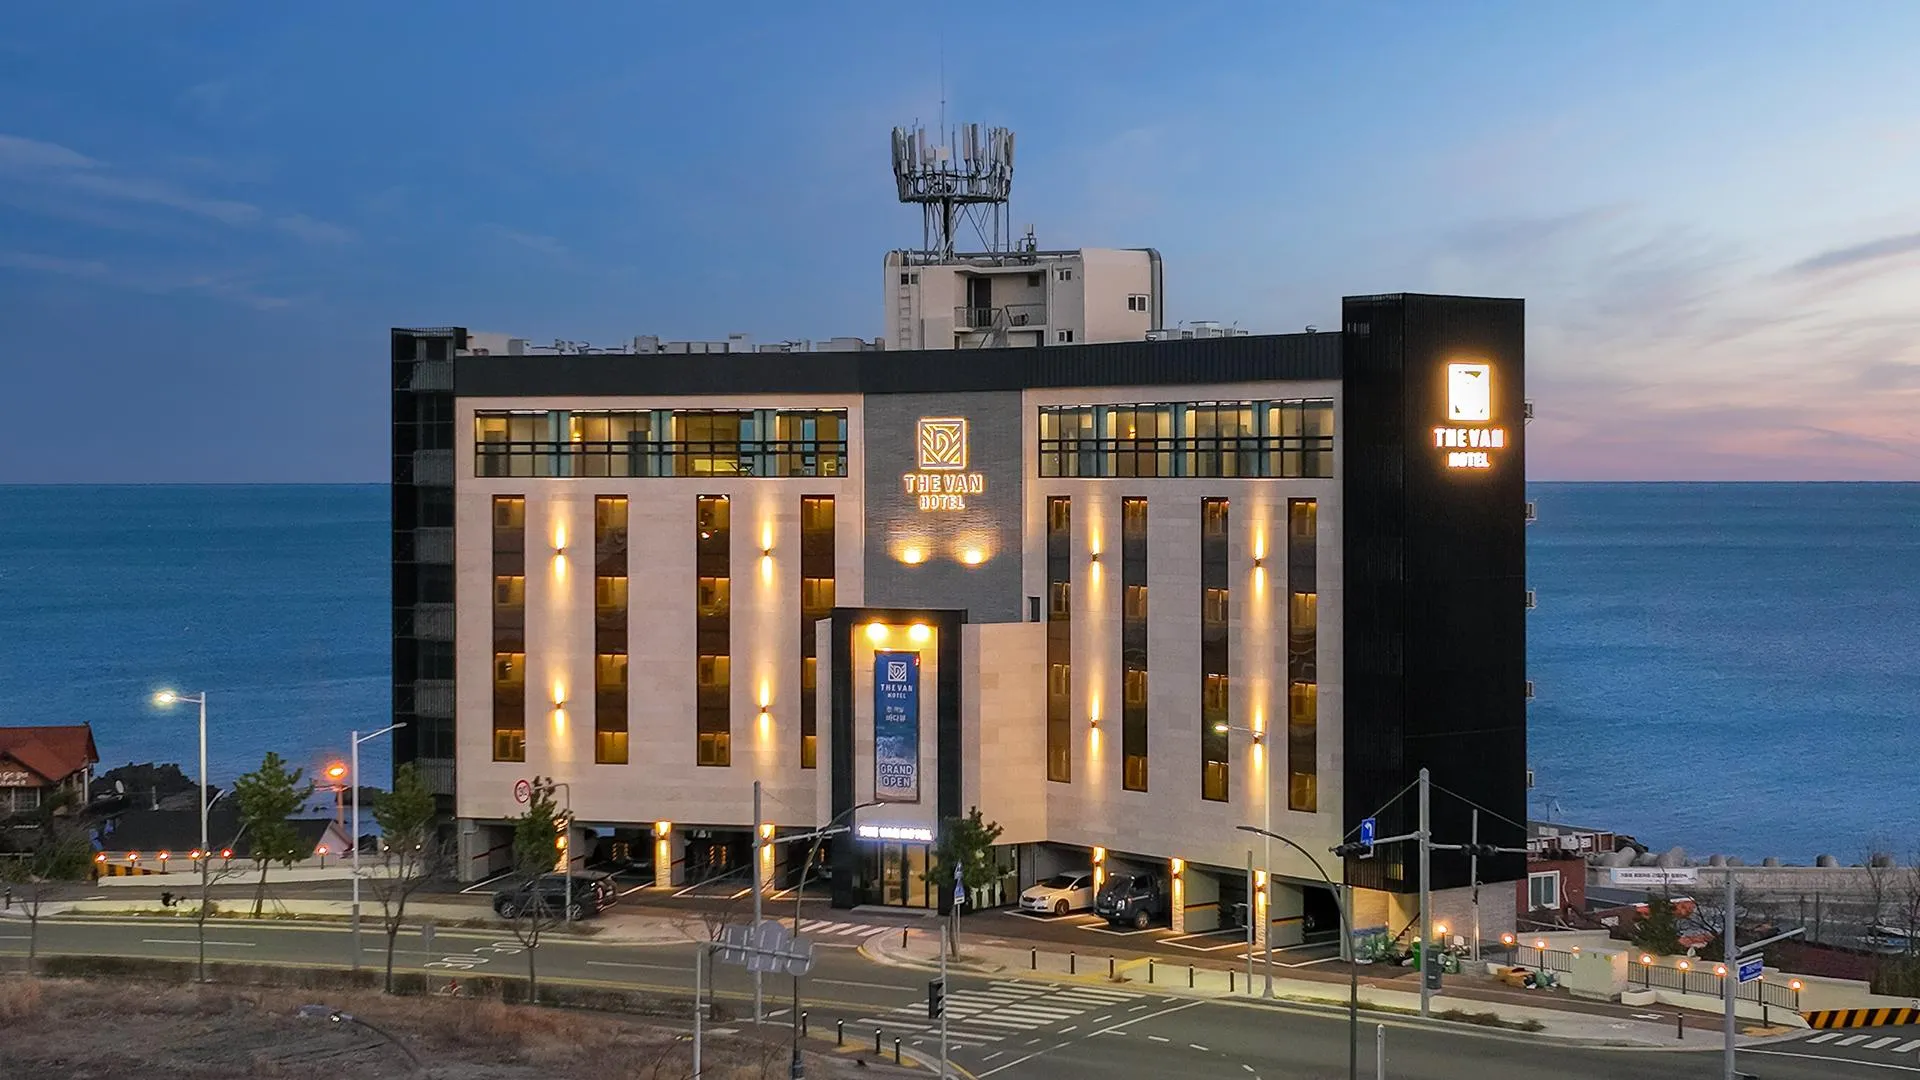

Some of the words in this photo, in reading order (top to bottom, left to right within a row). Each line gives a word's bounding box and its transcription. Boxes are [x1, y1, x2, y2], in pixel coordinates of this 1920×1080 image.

[903, 474, 941, 493] THE
[943, 474, 983, 493] VAN
[919, 494, 966, 510] HOTEL
[880, 684, 896, 692] THE
[897, 684, 913, 692] VAN
[880, 764, 913, 775] GRAND
[882, 776, 911, 787] OPEN
